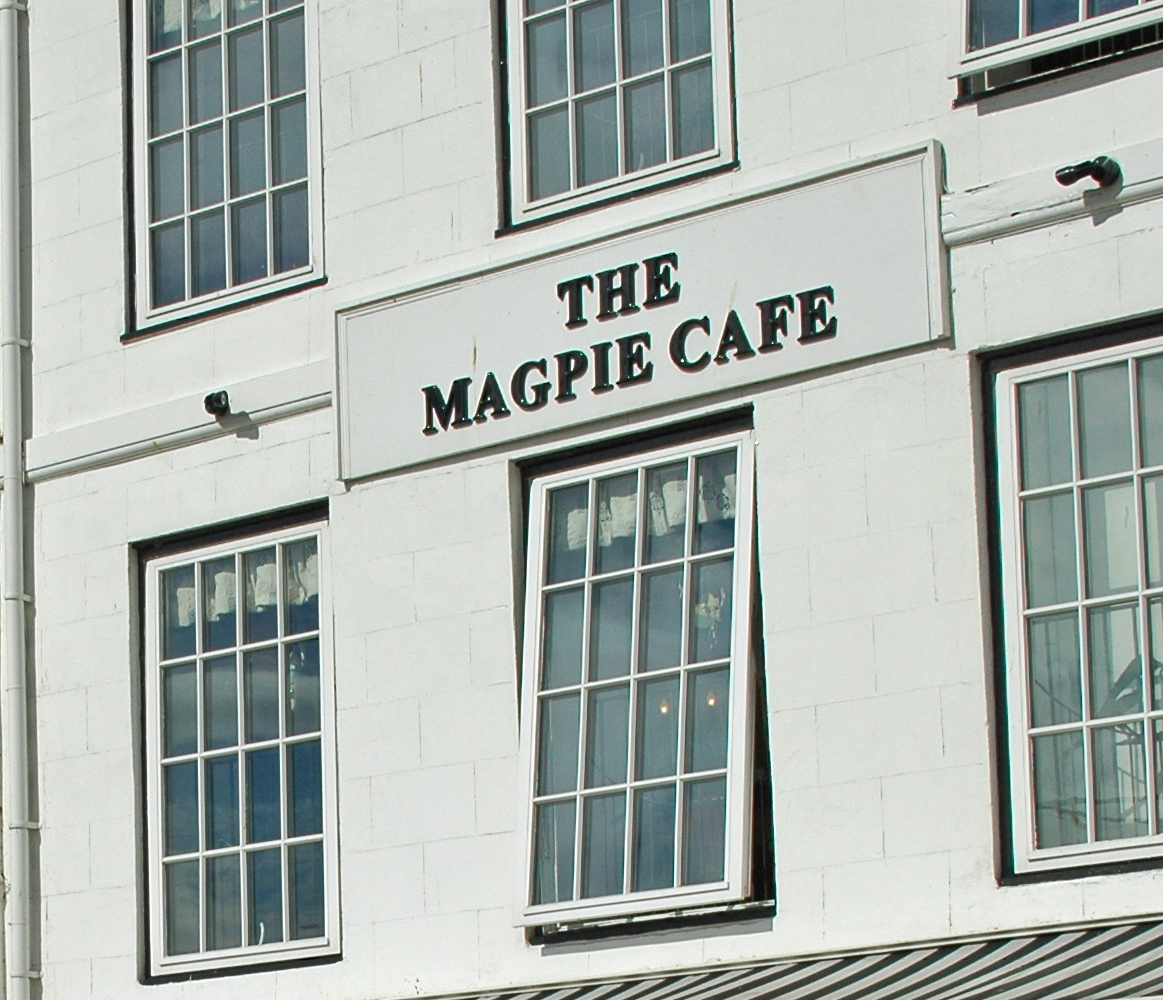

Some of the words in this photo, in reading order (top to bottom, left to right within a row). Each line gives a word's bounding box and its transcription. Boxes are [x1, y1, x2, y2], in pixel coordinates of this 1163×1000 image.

[557, 252, 681, 329] THE
[422, 332, 654, 436] MAGPIE
[669, 285, 838, 373] CAFE
